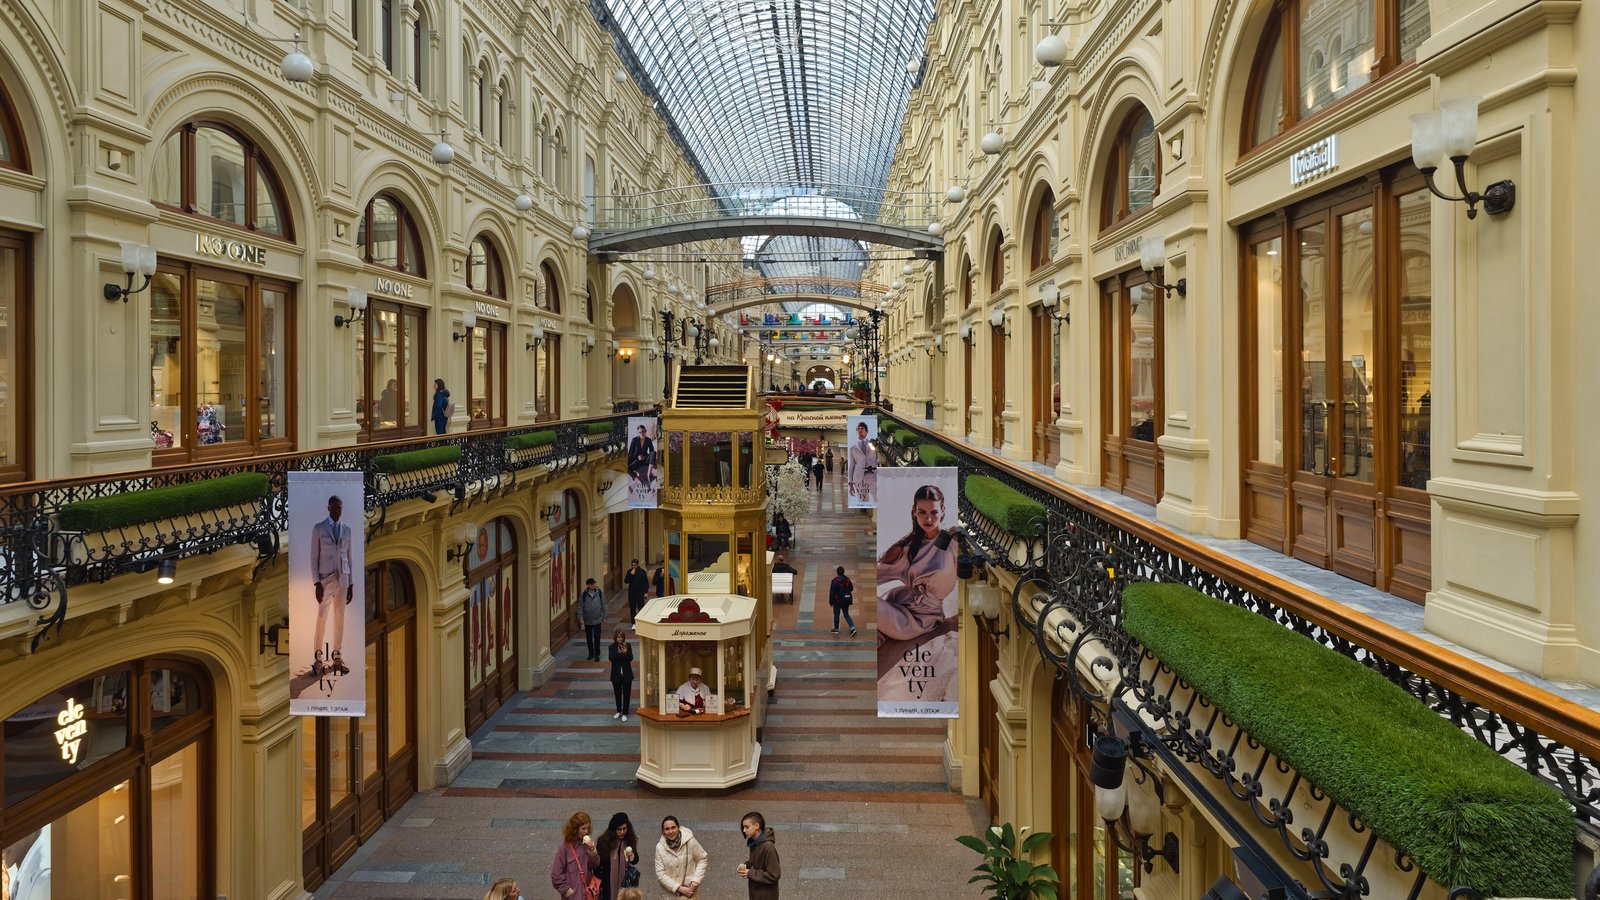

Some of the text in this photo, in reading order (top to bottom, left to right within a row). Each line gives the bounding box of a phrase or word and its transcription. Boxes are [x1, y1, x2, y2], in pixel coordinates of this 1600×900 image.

[1297, 145, 1328, 174] Wolford
[195, 233, 266, 266] NO ONE
[375, 277, 413, 298] NO ONE
[474, 300, 499, 317] NO ONE
[797, 413, 824, 422] Красной
[672, 629, 707, 637] Мороженое
[314, 642, 342, 662] ele
[903, 643, 932, 663] ele
[310, 664, 345, 677] ven
[899, 665, 936, 678] ven
[319, 674, 336, 698] ty
[907, 678, 928, 699] ty
[57, 697, 84, 726] ele
[53, 719, 88, 745] ven
[60, 738, 82, 765] ty
